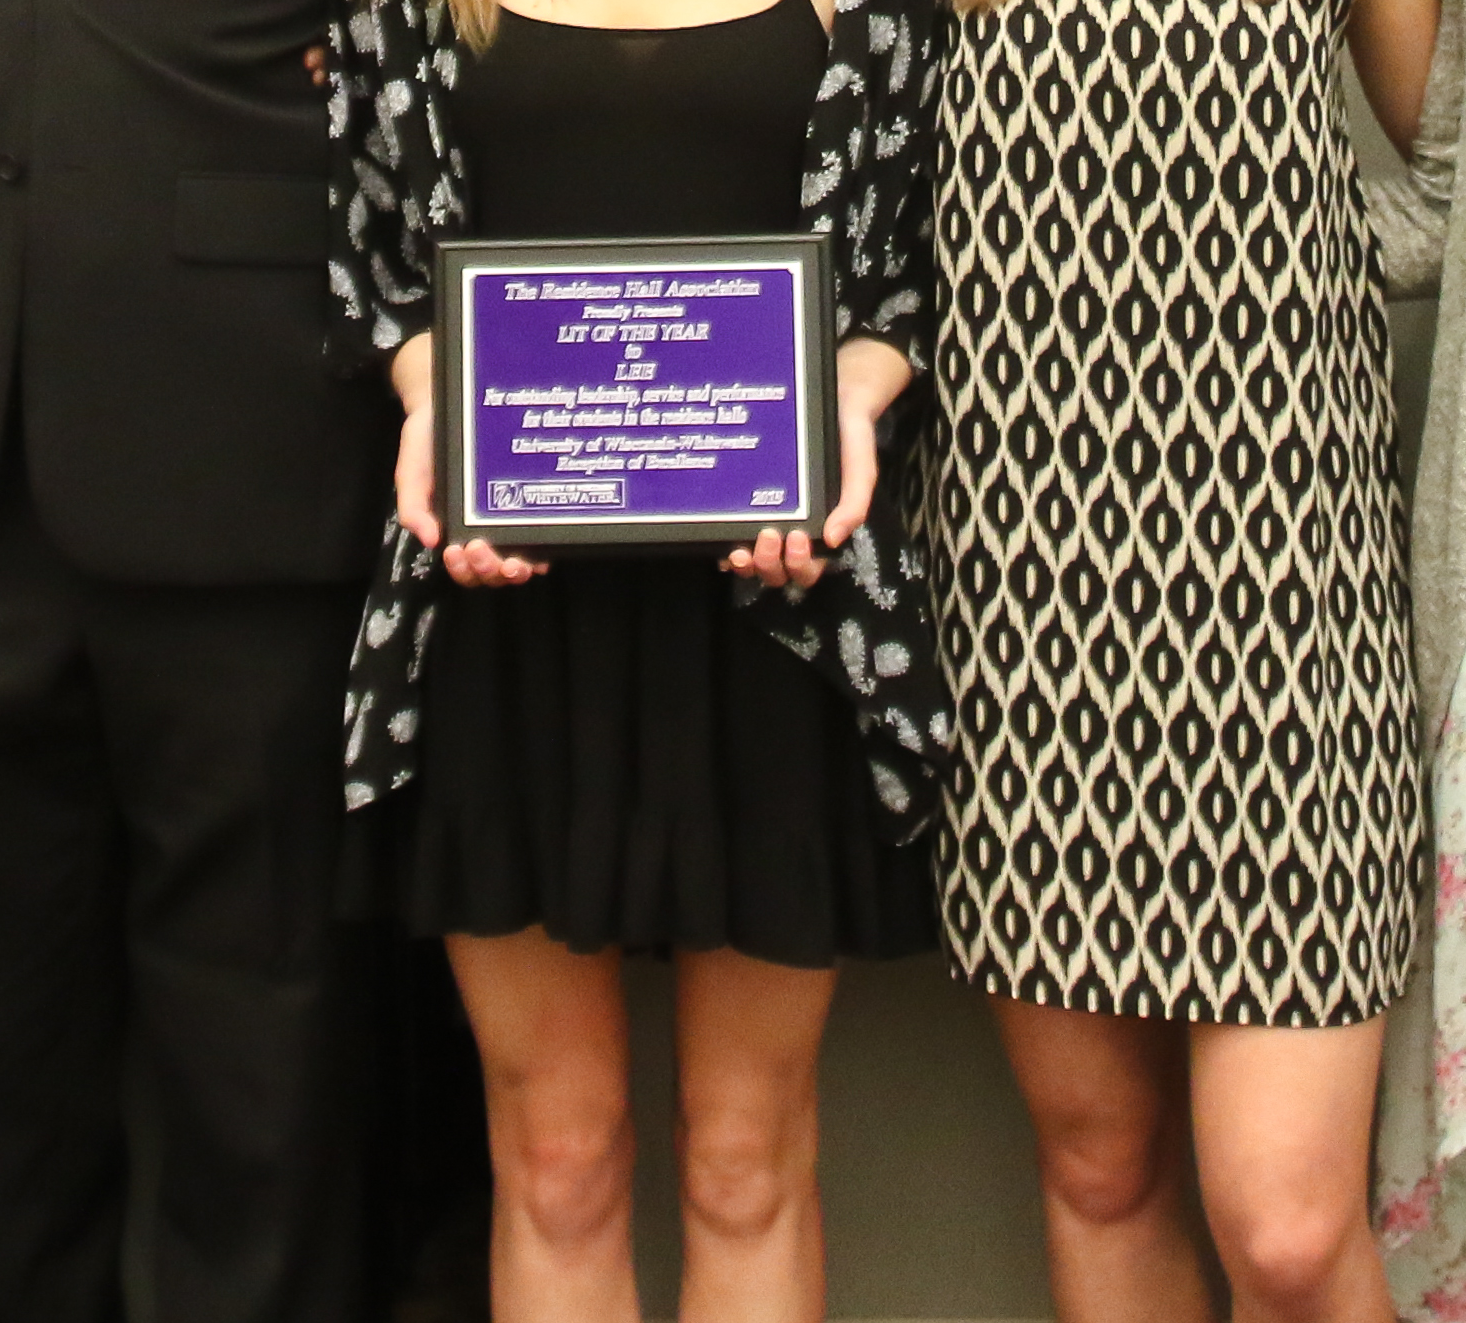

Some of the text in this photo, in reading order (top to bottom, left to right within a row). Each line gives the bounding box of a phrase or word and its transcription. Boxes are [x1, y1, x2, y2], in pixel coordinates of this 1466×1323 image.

[505, 278, 761, 300] The Residence Hall Association
[591, 325, 617, 342] OF
[619, 324, 658, 341] THE
[661, 323, 710, 341] YEAR
[624, 344, 643, 359] to
[483, 388, 505, 406] For
[686, 384, 710, 402] and
[522, 410, 541, 428] for
[624, 409, 638, 426] in
[640, 408, 660, 425] the
[716, 406, 747, 424] halls
[512, 437, 584, 456] University
[585, 436, 603, 452] of
[627, 454, 645, 470] of
